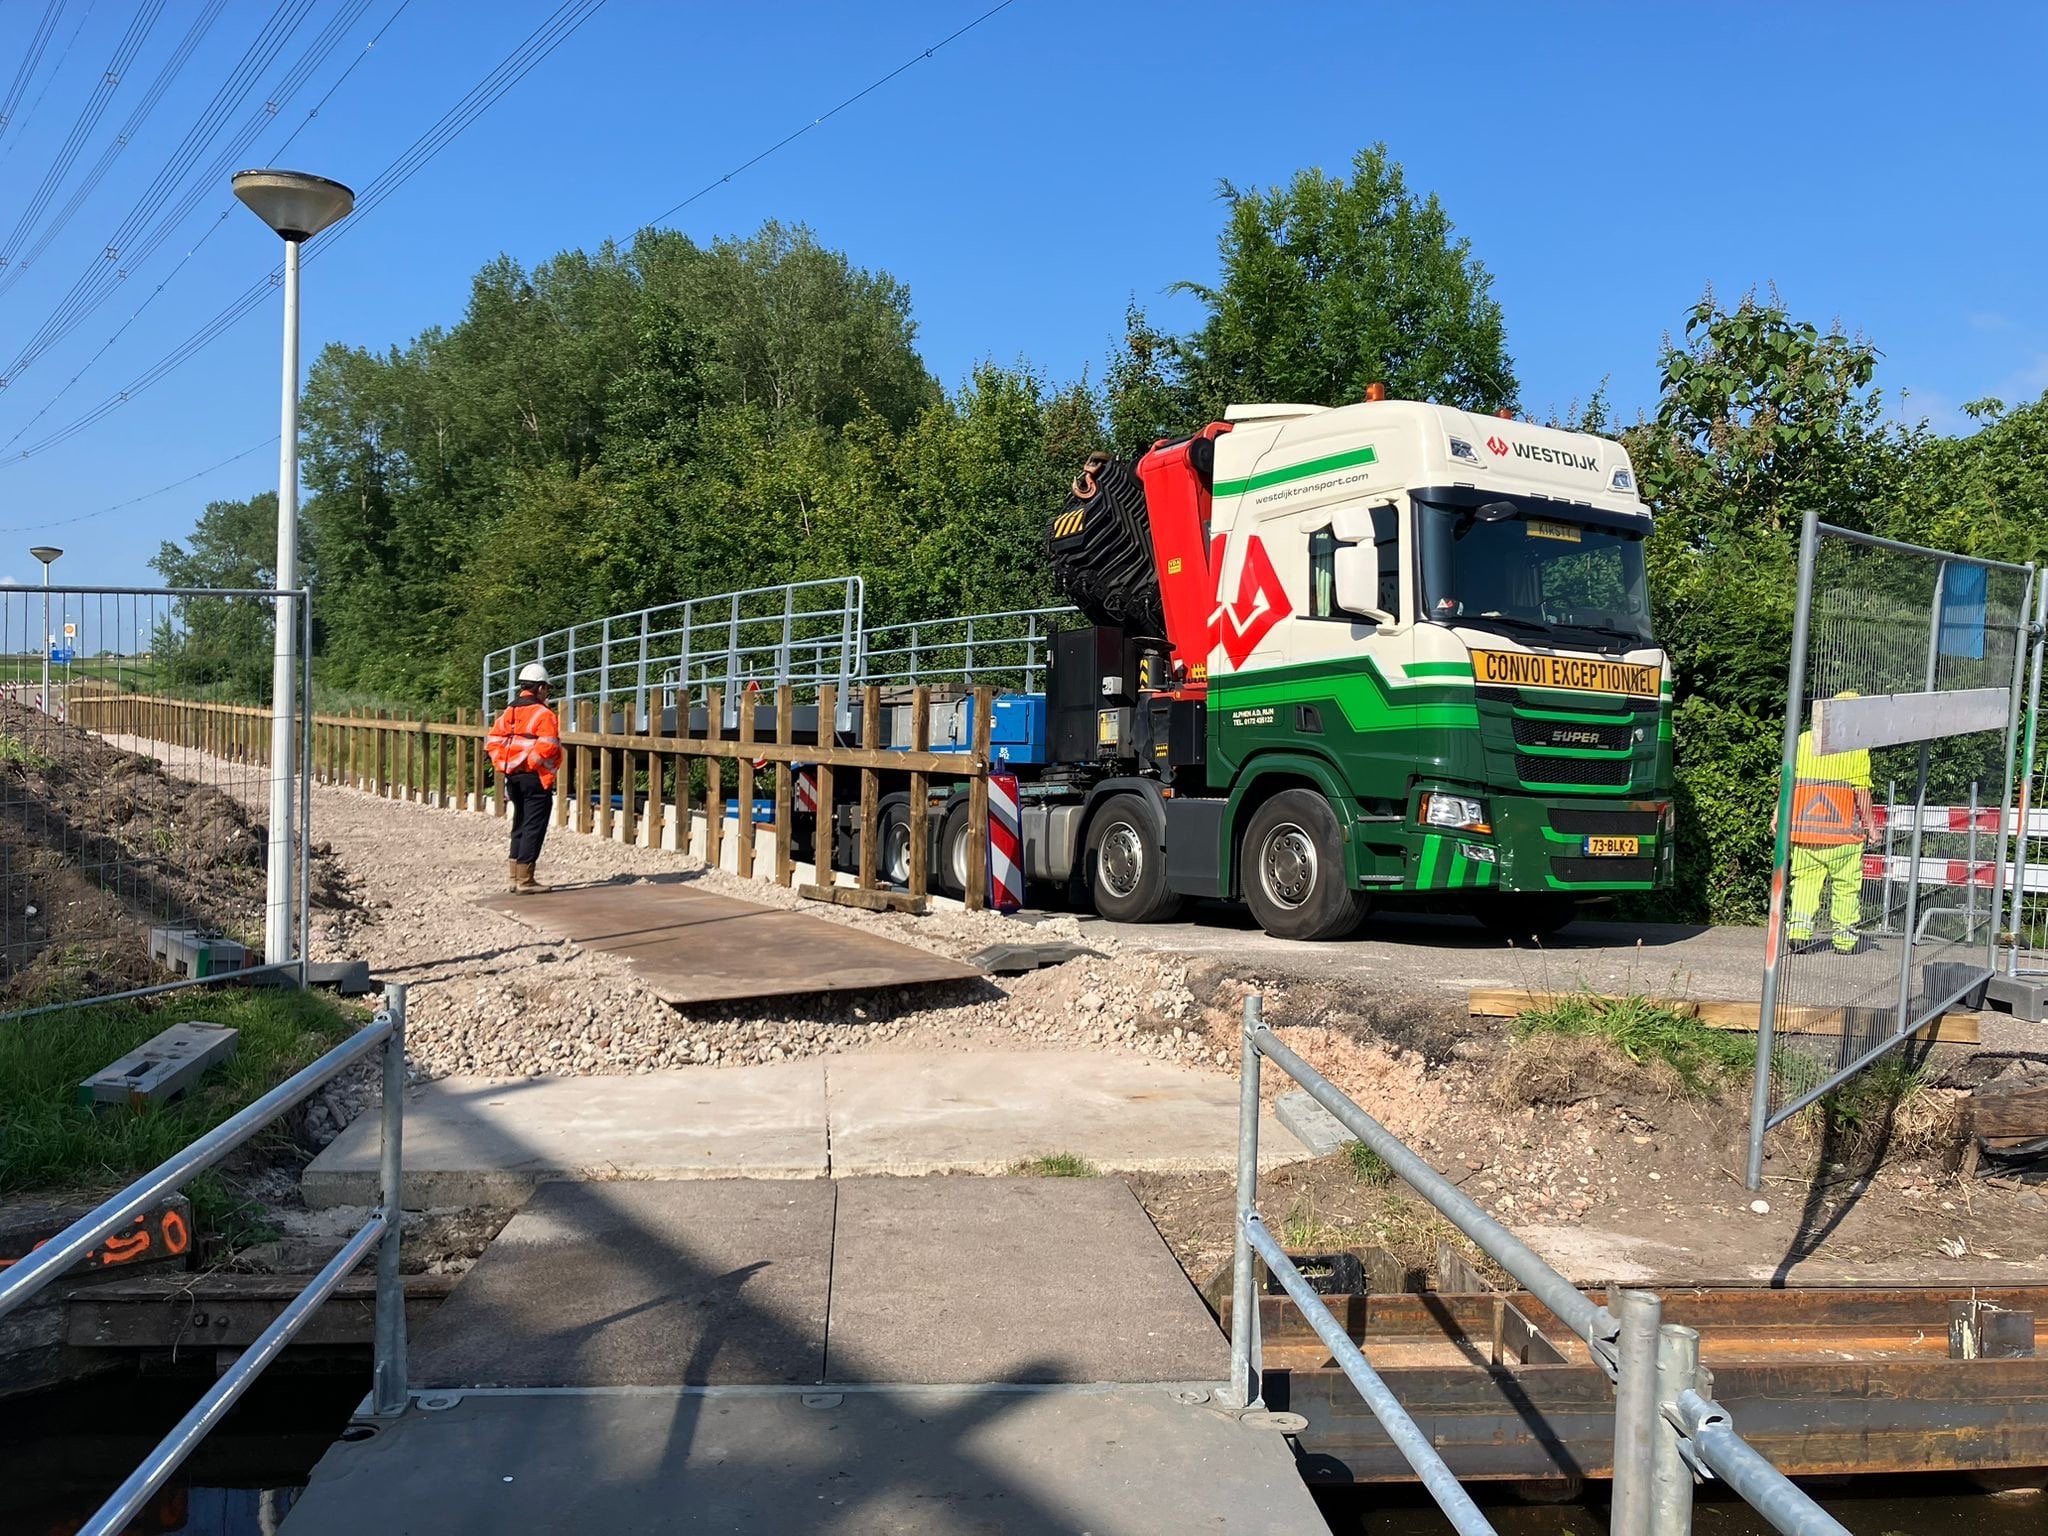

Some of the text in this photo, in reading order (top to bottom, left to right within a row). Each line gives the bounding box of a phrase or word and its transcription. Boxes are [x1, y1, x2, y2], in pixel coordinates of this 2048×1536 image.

[1512, 442, 1599, 472] WESTDIJK
[1255, 472, 1369, 505] westdijktransport.com
[1487, 653, 1654, 693] CONVOI EXCEPTIONNEL
[1552, 730, 1600, 744] SUPER
[1592, 839, 1634, 852] 73-BLK-2
